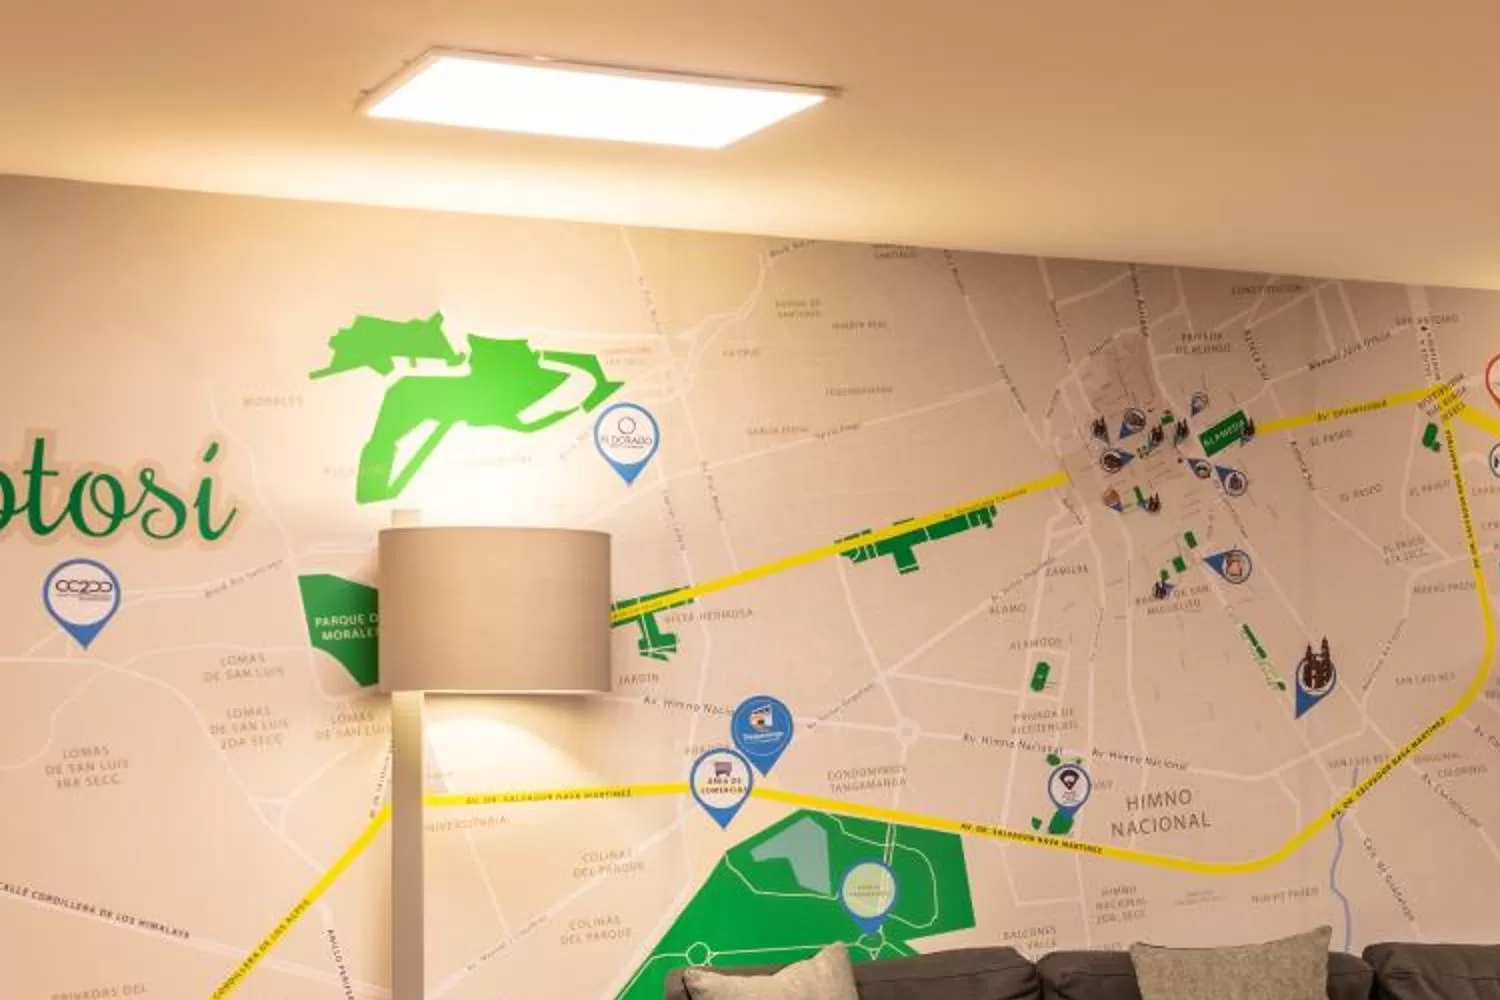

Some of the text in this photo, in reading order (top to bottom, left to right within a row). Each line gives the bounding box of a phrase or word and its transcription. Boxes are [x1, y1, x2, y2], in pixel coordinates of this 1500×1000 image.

[0, 437, 237, 541] tosí
[314, 610, 365, 630] PARQUE
[321, 626, 380, 642] MORALE
[63, 745, 110, 759] LOMAS
[1126, 788, 1194, 812] HIMNO
[1111, 811, 1212, 838] NACIONAL
